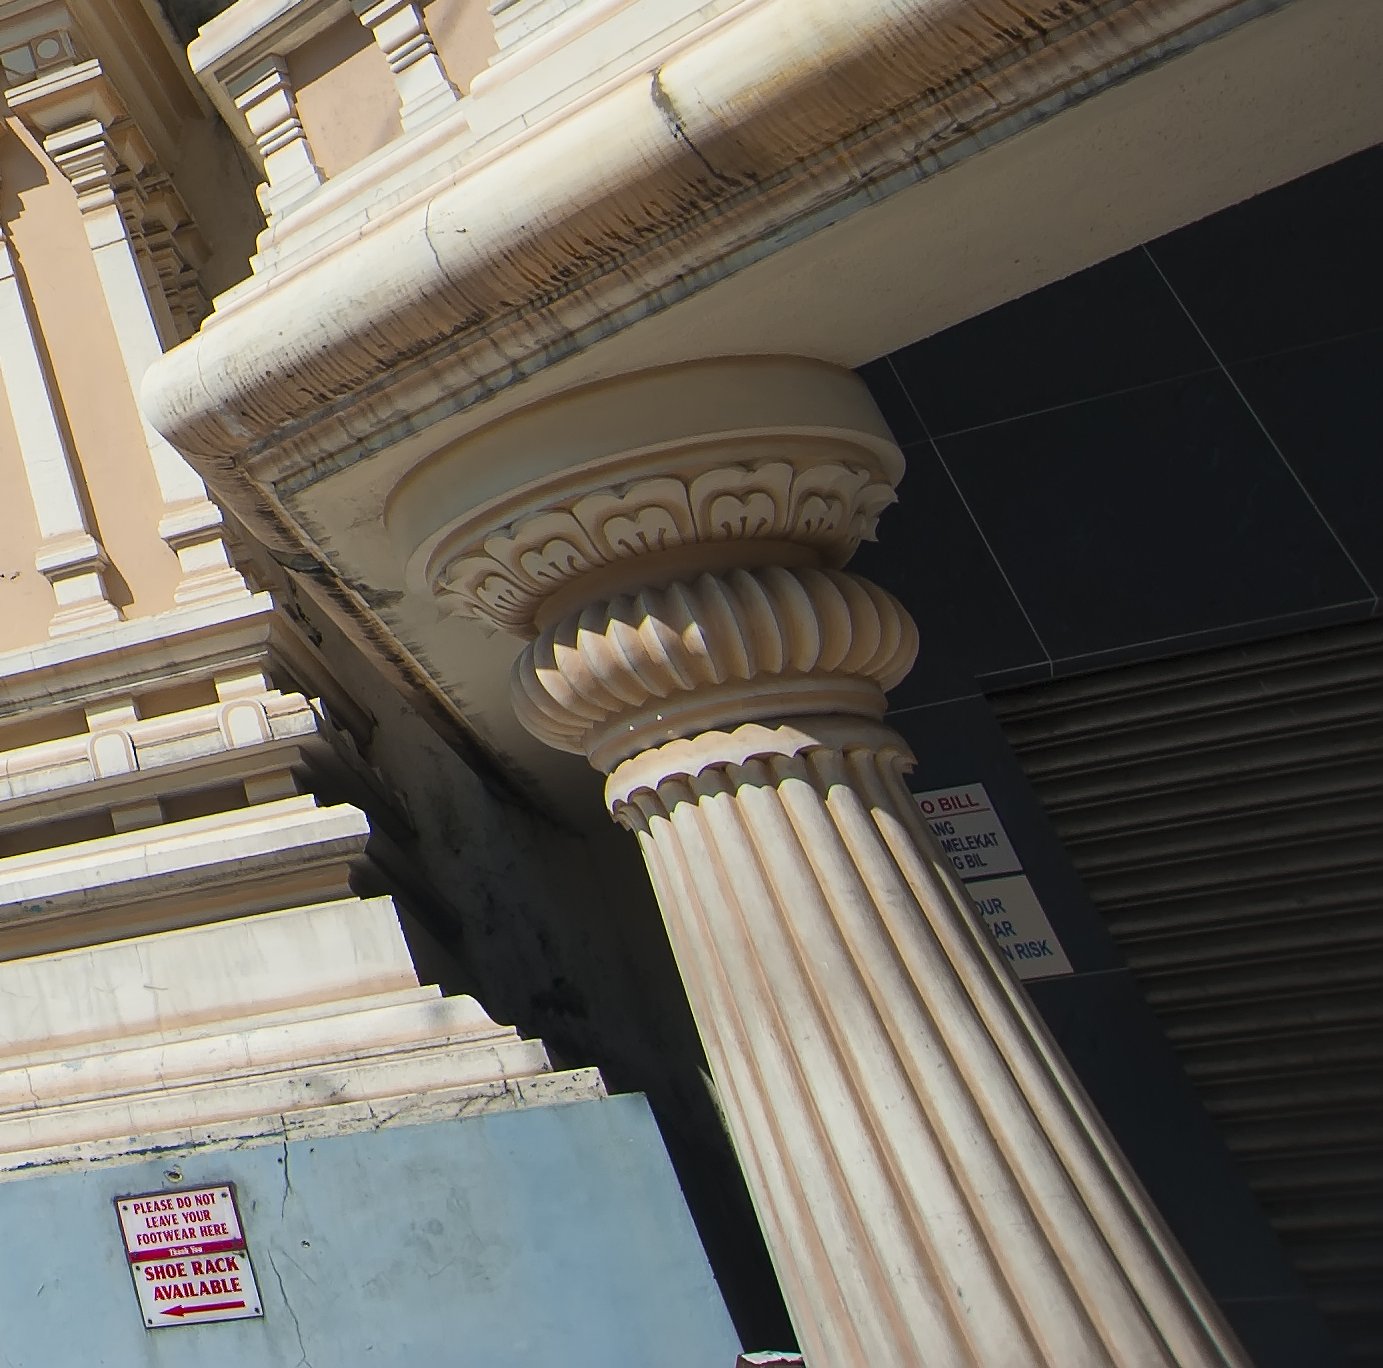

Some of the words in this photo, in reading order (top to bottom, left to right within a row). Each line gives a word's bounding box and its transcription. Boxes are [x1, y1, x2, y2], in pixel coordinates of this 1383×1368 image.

[938, 793, 980, 811] BILL
[941, 832, 999, 853] MELEKAT
[964, 853, 988, 868] BIL
[1014, 939, 1054, 960] RISK
[133, 1197, 174, 1215] PLEASE
[176, 1196, 192, 1209] DO
[194, 1192, 216, 1207] NOT
[145, 1214, 179, 1229] LEAVE
[181, 1209, 212, 1224] YOUR
[136, 1227, 197, 1246] FOOTWEAR
[199, 1223, 229, 1238] HERE
[144, 1263, 188, 1282] SHOE
[190, 1256, 240, 1276] RACK
[154, 1277, 243, 1302] AVAILABLE
